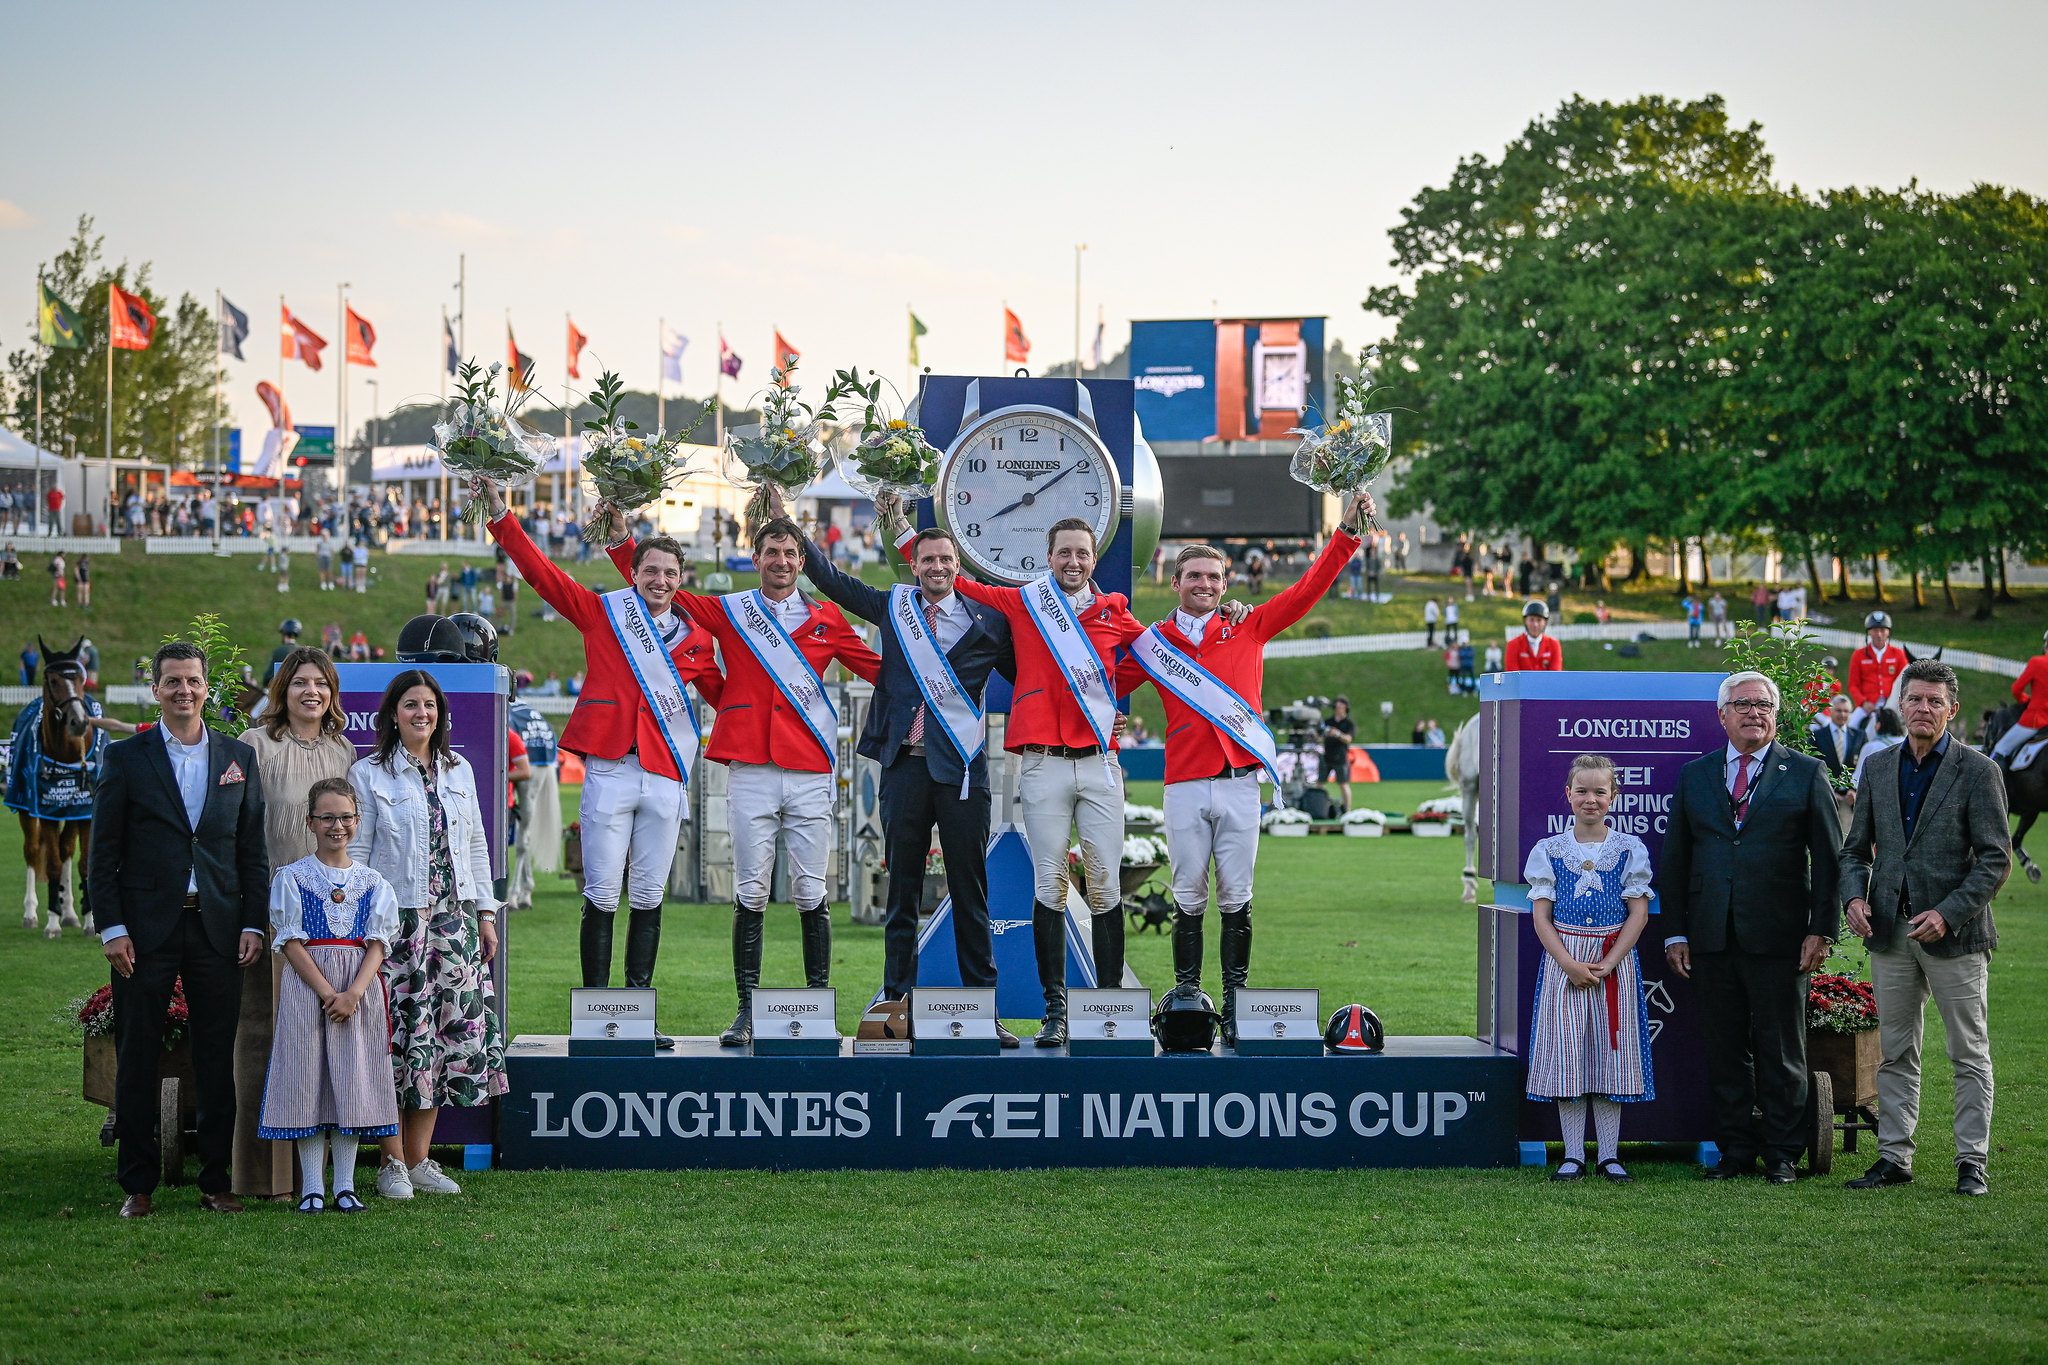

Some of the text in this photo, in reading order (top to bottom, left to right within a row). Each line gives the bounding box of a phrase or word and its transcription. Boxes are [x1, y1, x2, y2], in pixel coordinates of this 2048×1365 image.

[1019, 428, 1038, 442] 12
[990, 437, 1003, 450] 11
[1059, 437, 1065, 451] 1
[968, 458, 987, 473] 10
[997, 460, 1060, 470] LONGINES
[1076, 460, 1090, 474] 2
[957, 491, 972, 506] 9
[1084, 492, 1099, 507] 3
[966, 523, 981, 538] 8
[990, 548, 1004, 561] 7
[1020, 556, 1035, 570] 6
[901, 587, 923, 641] LONGINES
[1037, 581, 1070, 633] LONGINES
[623, 596, 655, 654] LONGINES
[740, 595, 781, 648] LONGINES
[1151, 643, 1202, 687] LONGINES
[1558, 718, 1691, 738] LONGINES
[1608, 794, 1673, 813] MPIN
[1547, 815, 1649, 834] NAONS
[588, 1004, 639, 1012] LONGINES
[768, 1004, 819, 1012] LONGINES
[928, 1003, 979, 1011] LONGINES
[1083, 1004, 1133, 1012] LONGINES
[1251, 1004, 1301, 1012] LONGINES
[531, 1091, 871, 1138] LONGINES
[1083, 1092, 1337, 1138] NATIONS
